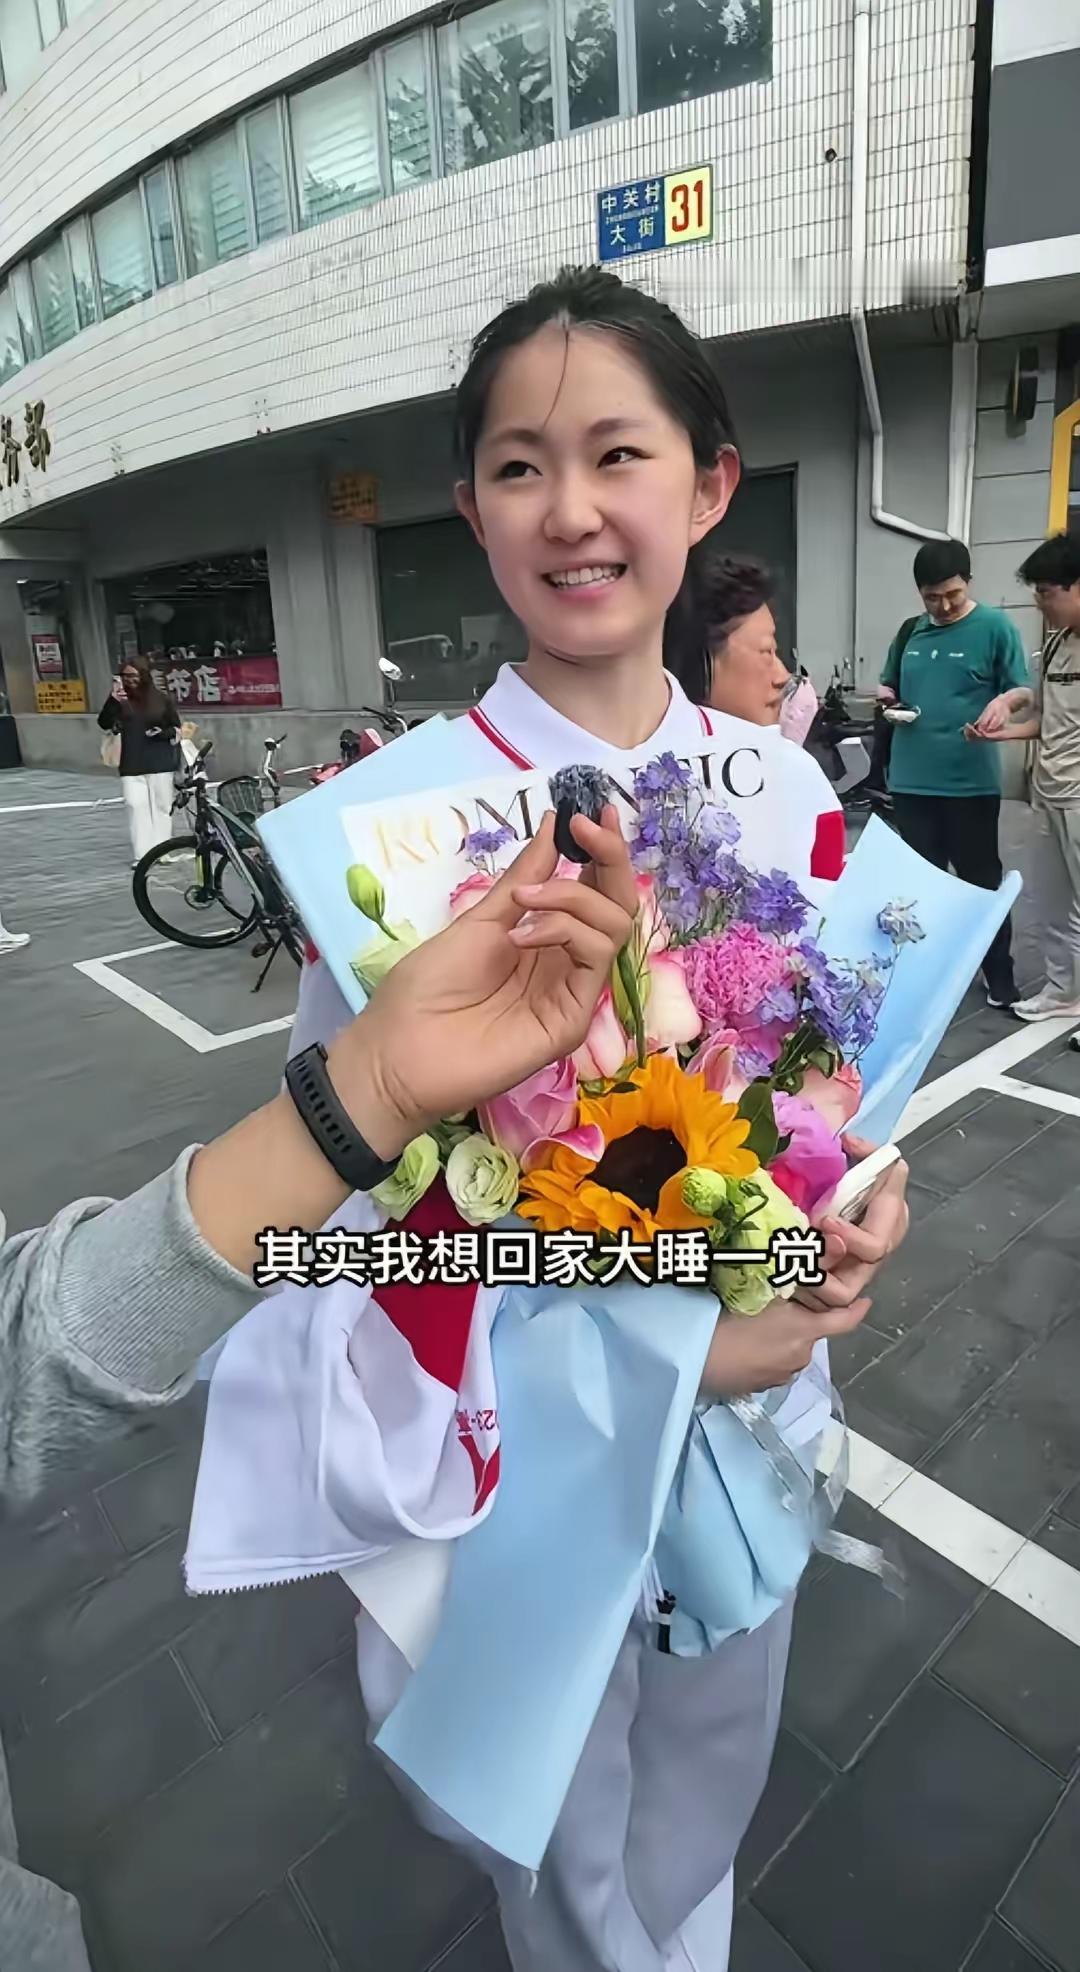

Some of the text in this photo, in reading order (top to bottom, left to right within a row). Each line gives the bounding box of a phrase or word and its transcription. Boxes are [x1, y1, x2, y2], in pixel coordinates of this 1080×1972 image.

[601, 181, 662, 215] 中关村
[670, 179, 704, 233] 31
[609, 216, 655, 246] 大街
